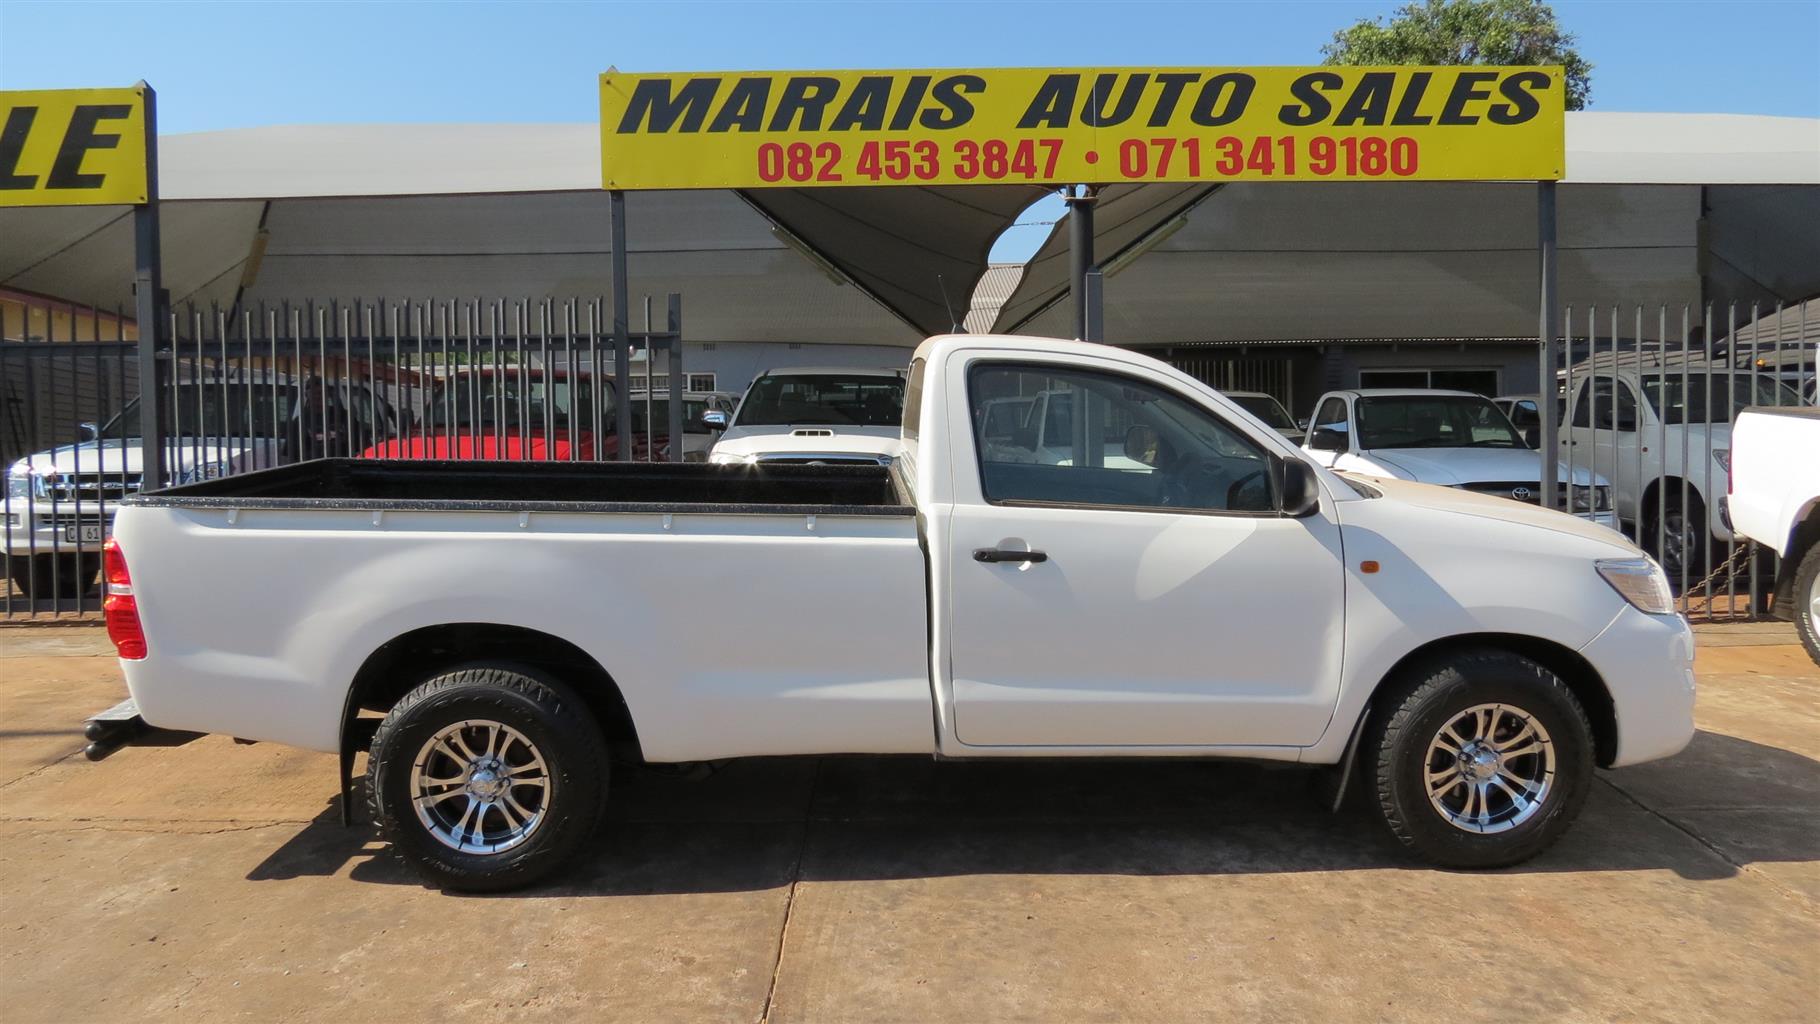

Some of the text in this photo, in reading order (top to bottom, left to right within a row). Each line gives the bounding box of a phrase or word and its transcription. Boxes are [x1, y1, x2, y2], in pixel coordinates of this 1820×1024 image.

[616, 71, 1553, 135] MARAIS AUTO SALES
[757, 135, 1419, 183] 082 453 3847 071 341 9180
